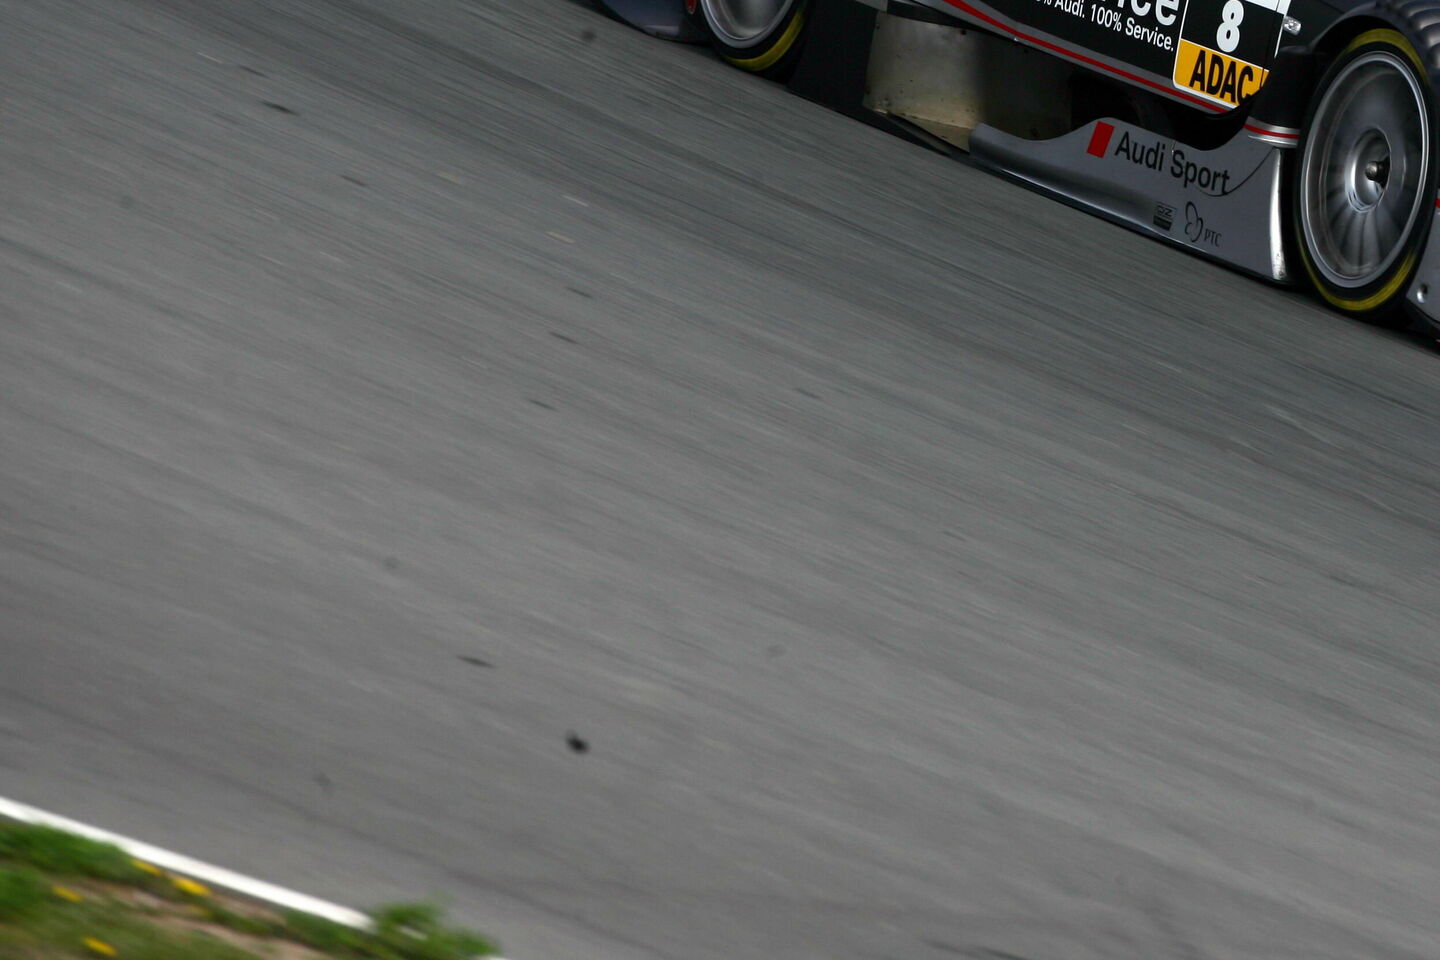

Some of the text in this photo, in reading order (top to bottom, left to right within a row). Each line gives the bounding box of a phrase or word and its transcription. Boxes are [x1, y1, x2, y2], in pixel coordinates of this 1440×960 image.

[1091, 3, 1122, 32] 100%
[1125, 17, 1175, 52] Service.
[1216, 0, 1245, 53] 8
[1189, 49, 1254, 107] ADAC
[1114, 131, 1231, 196] Audi Sport
